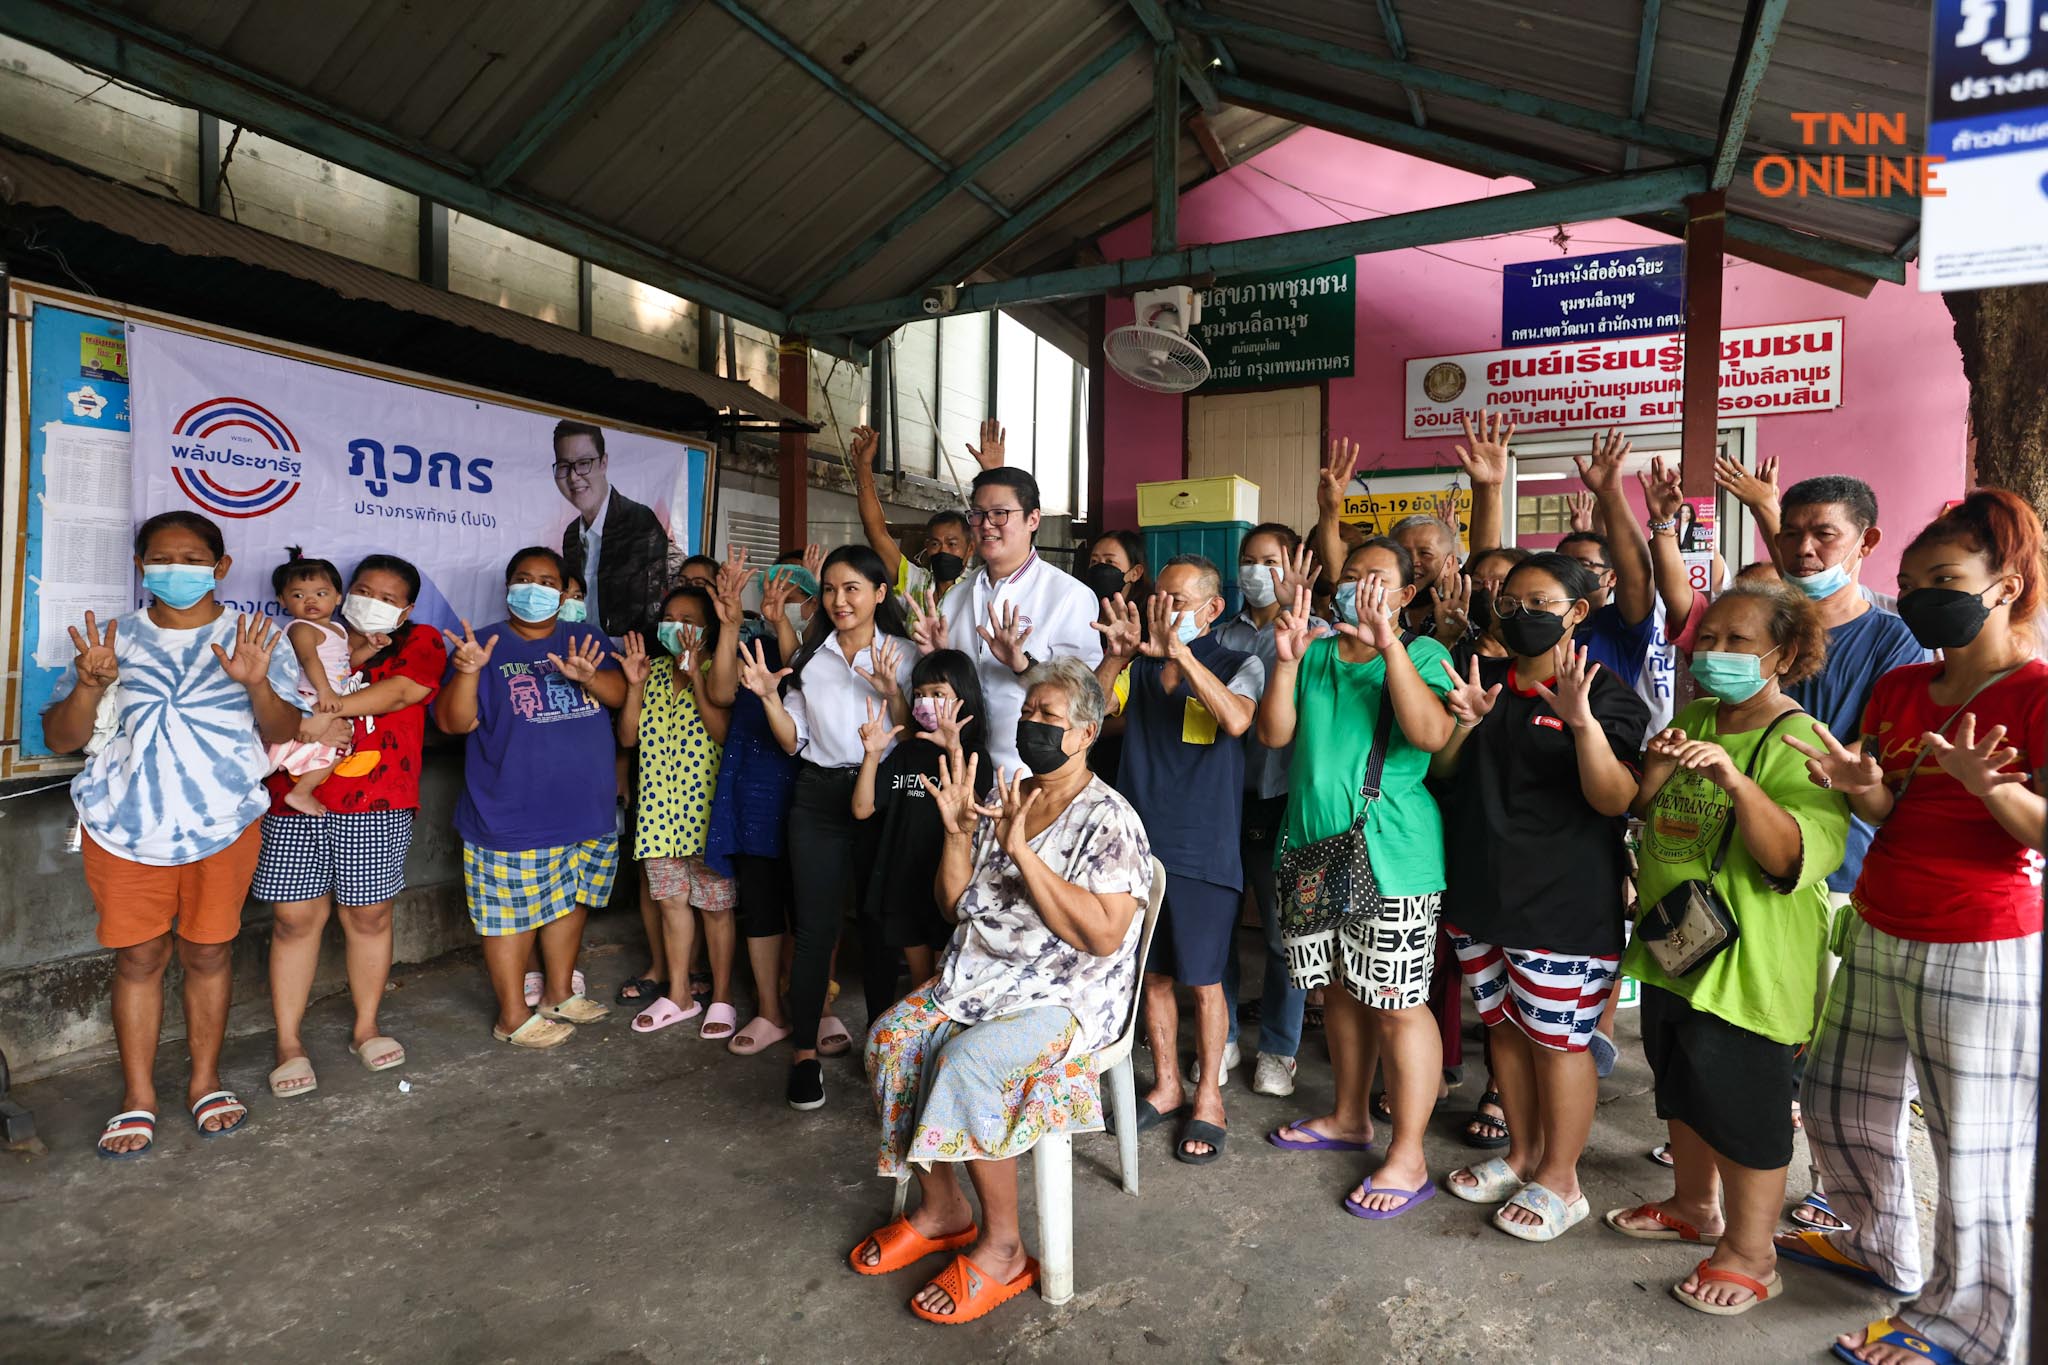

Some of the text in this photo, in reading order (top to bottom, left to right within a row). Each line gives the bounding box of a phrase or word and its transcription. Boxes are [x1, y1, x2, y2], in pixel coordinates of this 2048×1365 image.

[1200, 273, 1348, 317] ยสุขภาพชุมชน
[1560, 289, 1636, 316] ชุมชนลีลานุช
[1200, 309, 1310, 346] ชุมชนลีลานุช
[1597, 314, 1653, 334] สำนักงาน
[1247, 355, 1351, 383] กรุงเทพมหานคร
[1486, 336, 1685, 388] ศูนย์เรียนรู้
[171, 443, 302, 478] พลังประชารัฐ
[348, 438, 494, 498] ภูวกร
[354, 500, 457, 524] ปรางภรพิทักษ์
[1689, 565, 1707, 590] 8
[499, 661, 561, 678] TUK TU
[906, 789, 926, 798] PARIS
[1656, 792, 1726, 821] OENTRANCE
